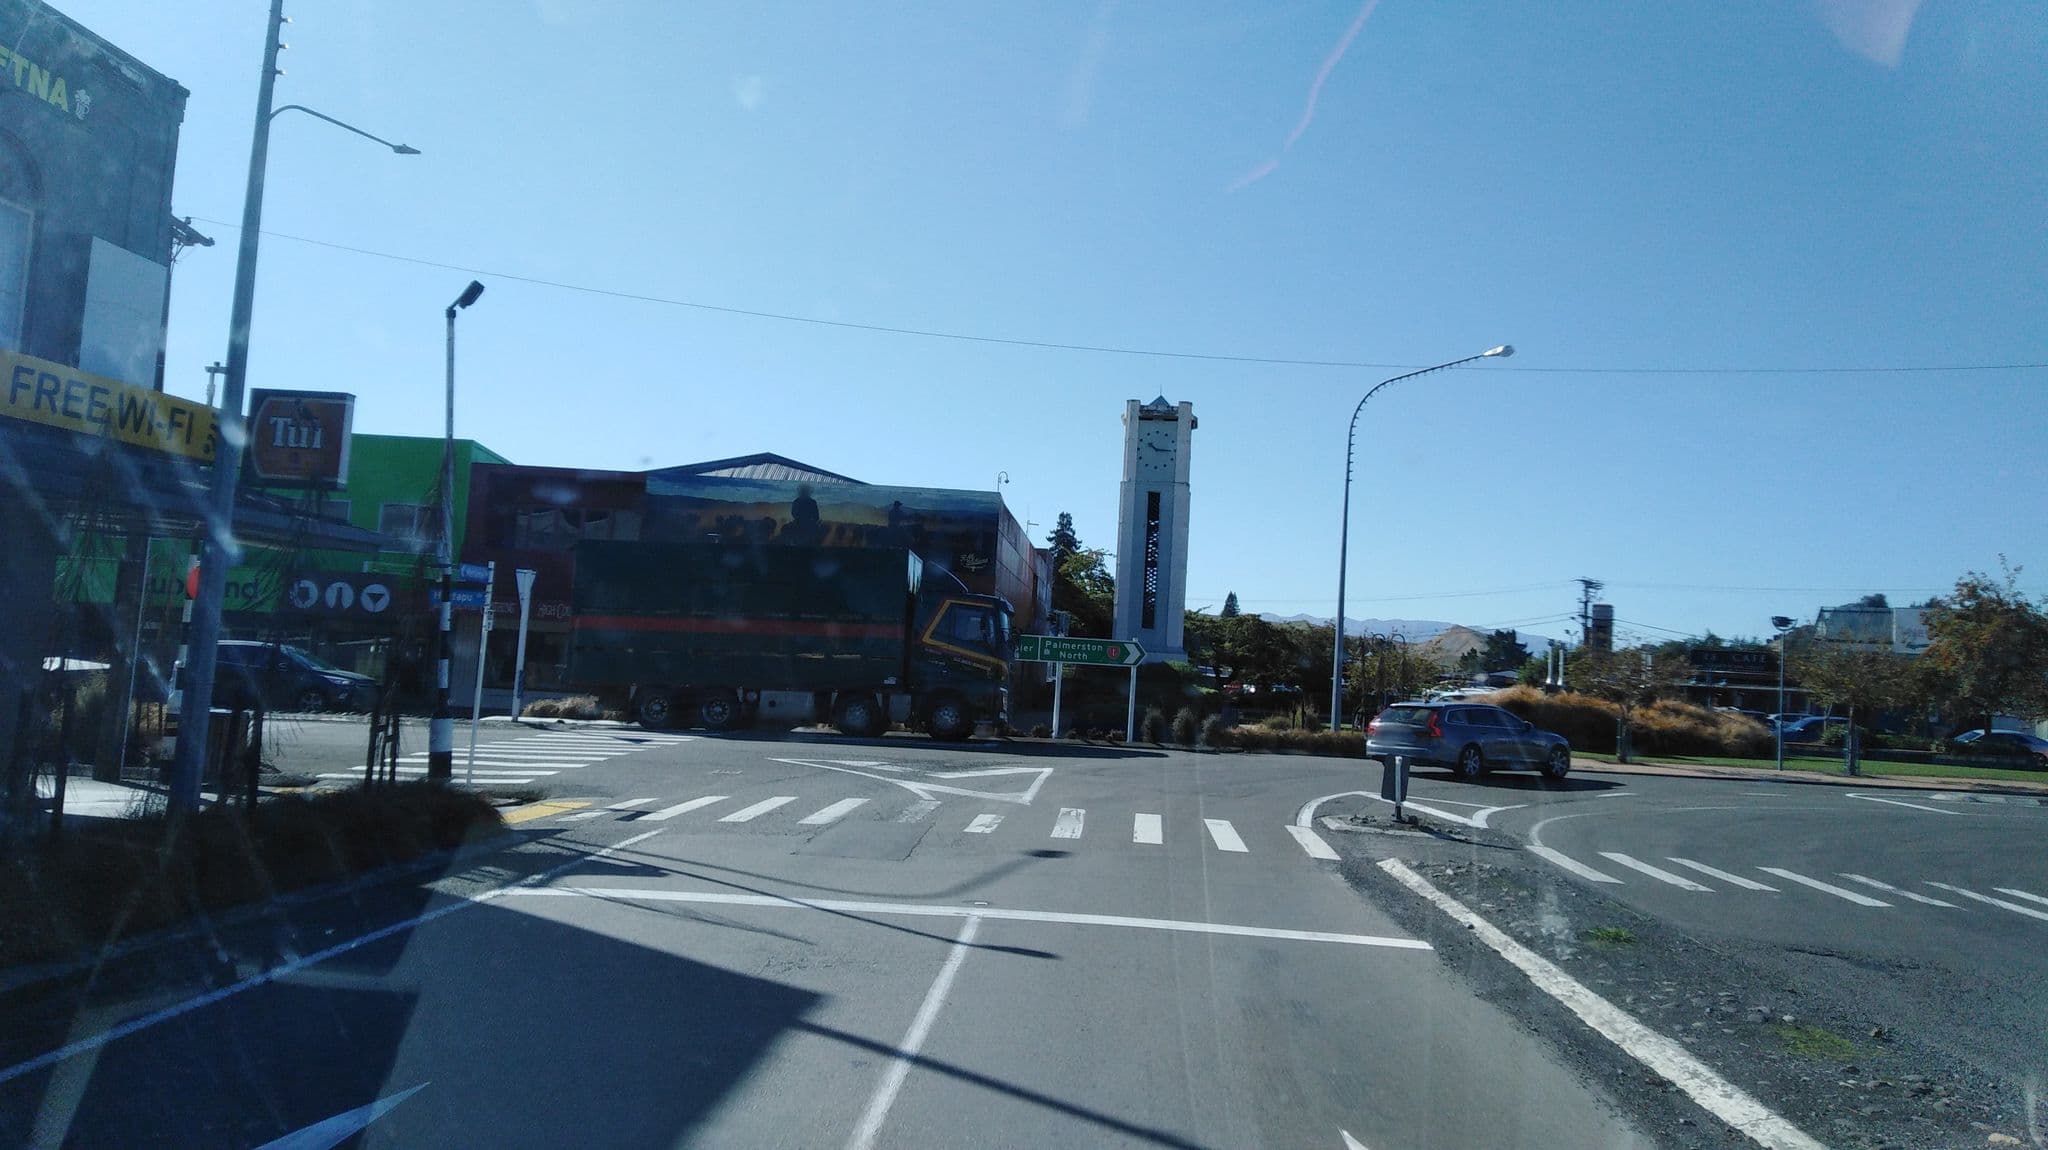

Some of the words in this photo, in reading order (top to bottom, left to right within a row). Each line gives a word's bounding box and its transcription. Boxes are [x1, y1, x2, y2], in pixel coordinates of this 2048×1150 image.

[9, 365, 110, 424] FREE
[117, 391, 194, 445] WI-FI
[270, 416, 321, 448] Tui
[1045, 640, 1103, 652] Palmerston
[1059, 651, 1088, 660] North
